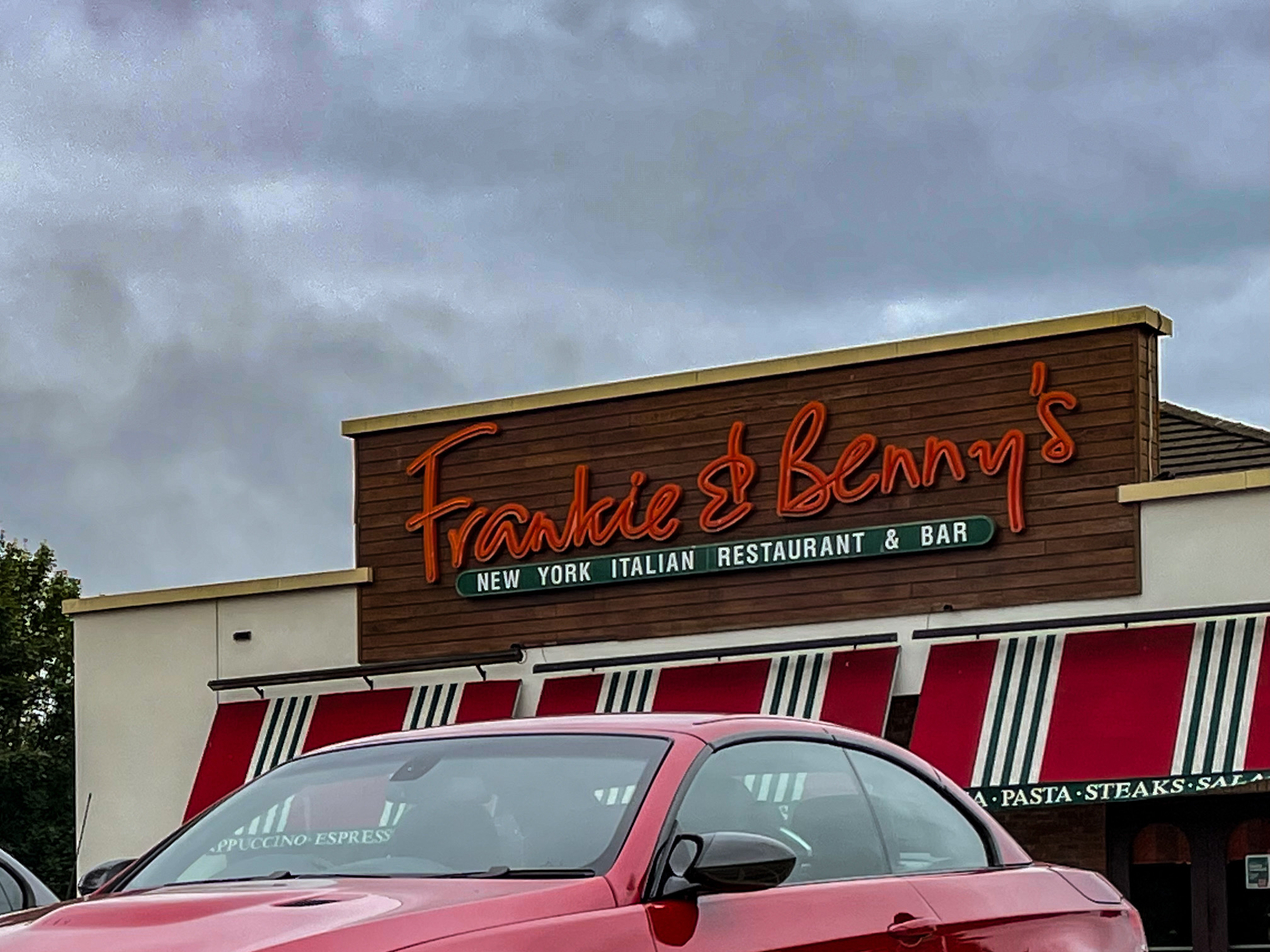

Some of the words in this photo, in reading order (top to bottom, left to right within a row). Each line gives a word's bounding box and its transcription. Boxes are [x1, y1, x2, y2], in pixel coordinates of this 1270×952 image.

[406, 422, 682, 583] Frankie
[697, 421, 757, 533] &
[776, 361, 1077, 533] Benny's
[477, 569, 521, 592] NEW
[537, 562, 591, 586] YORK
[611, 550, 695, 578] ITALIAN
[717, 532, 865, 567] RESTAURANT
[884, 528, 900, 550] &
[921, 521, 968, 547] BAR
[1001, 786, 1073, 807] PASTA
[1084, 778, 1184, 801] STEAKS
[315, 829, 395, 845] ESPRESS
